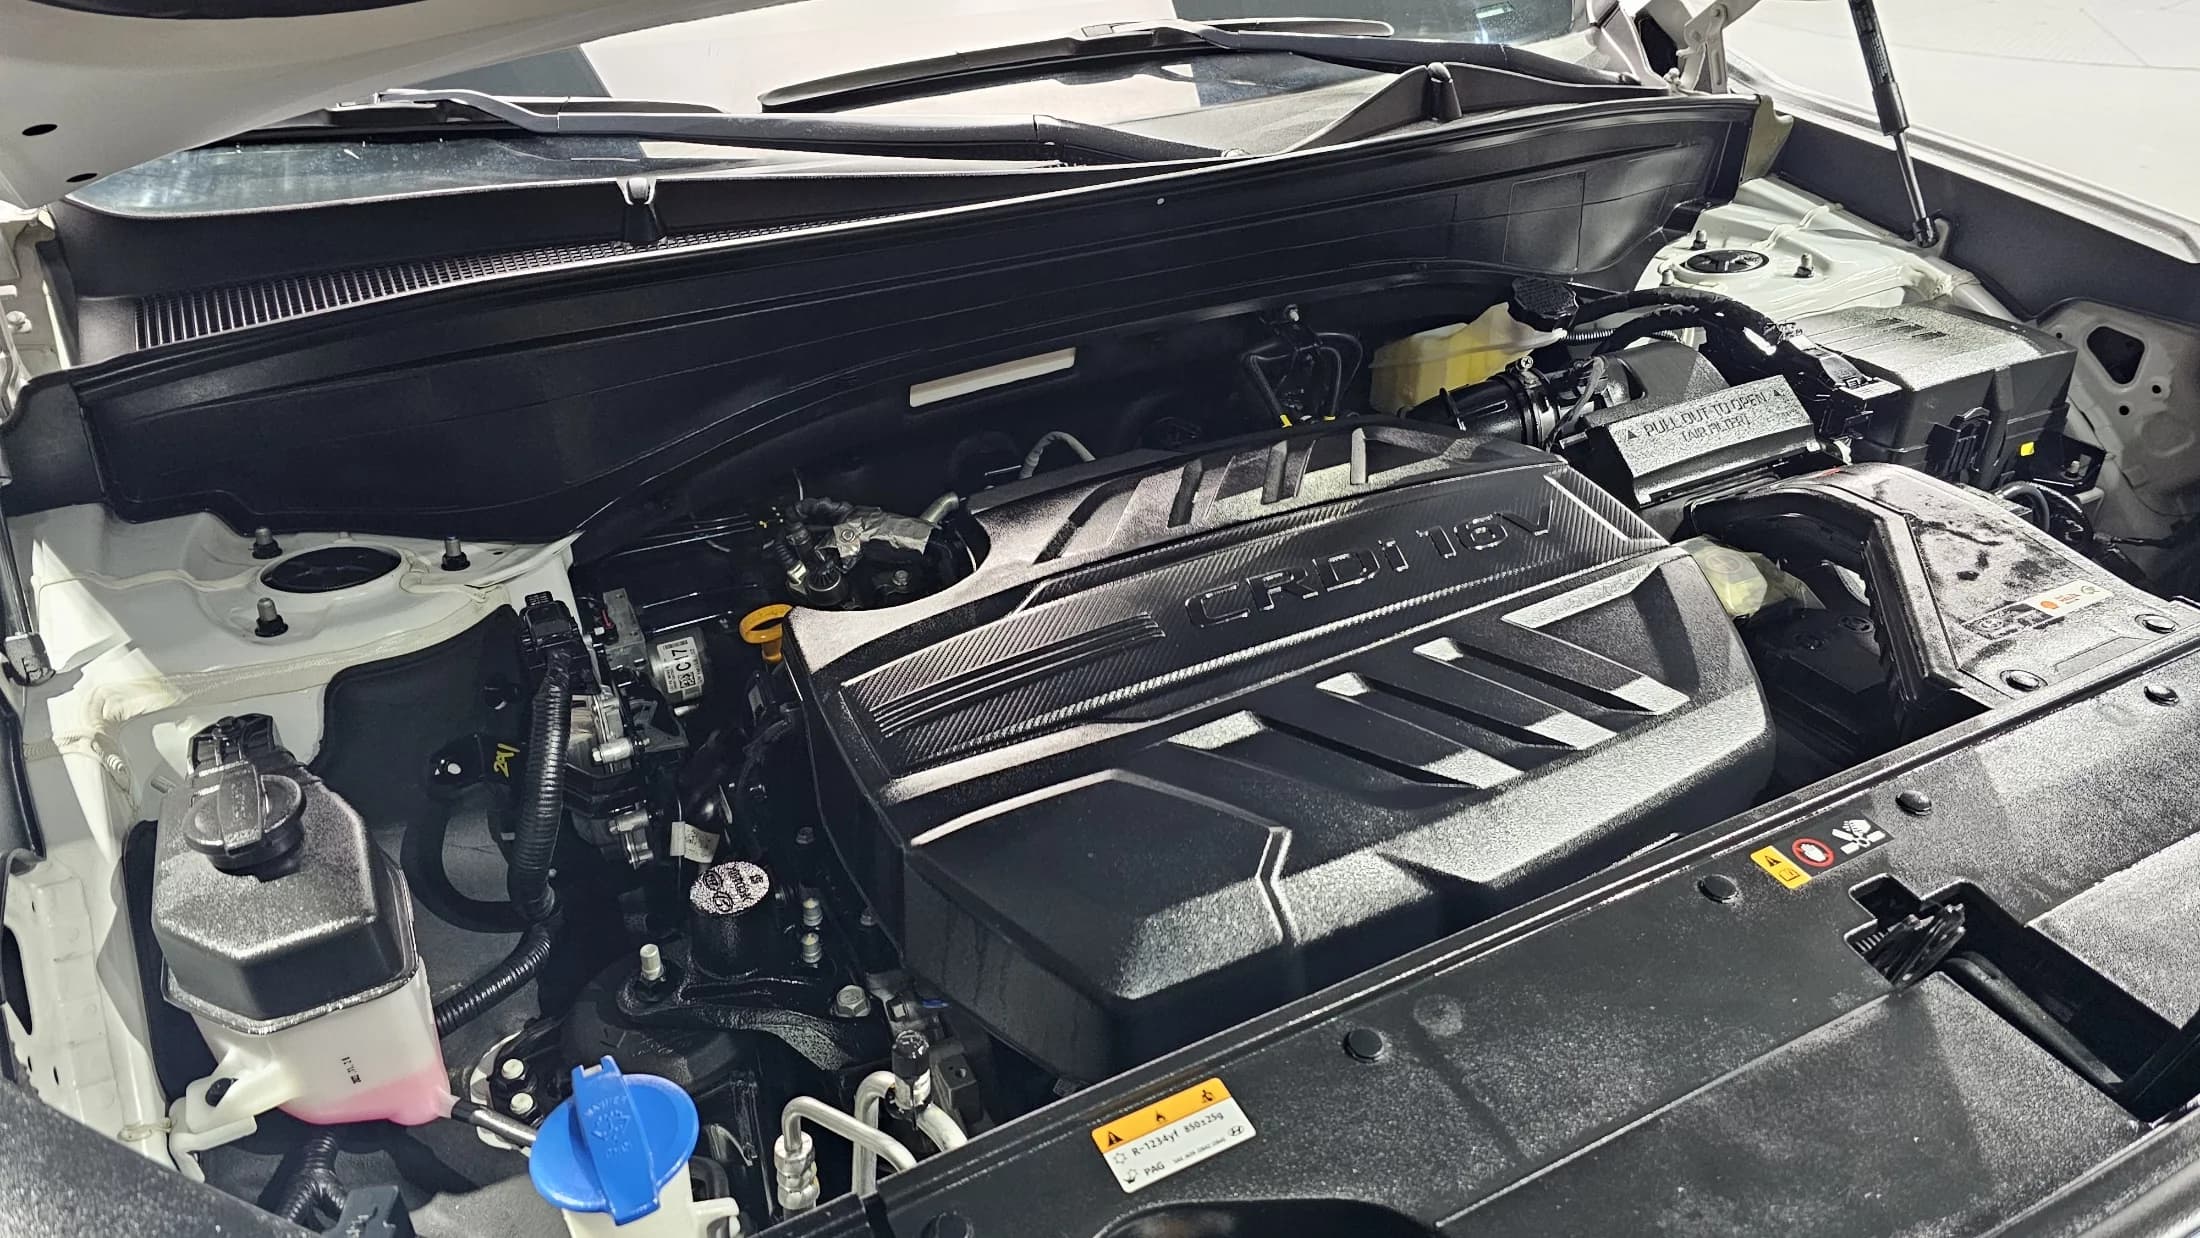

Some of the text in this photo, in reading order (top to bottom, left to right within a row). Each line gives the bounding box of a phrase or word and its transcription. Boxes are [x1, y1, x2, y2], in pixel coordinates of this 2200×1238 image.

[1643, 391, 1769, 437] PULL OUT TO OPEN
[1415, 499, 1554, 559] 16V
[1131, 1129, 1180, 1156] R-1234yf
[1143, 1161, 1166, 1176] PAG
